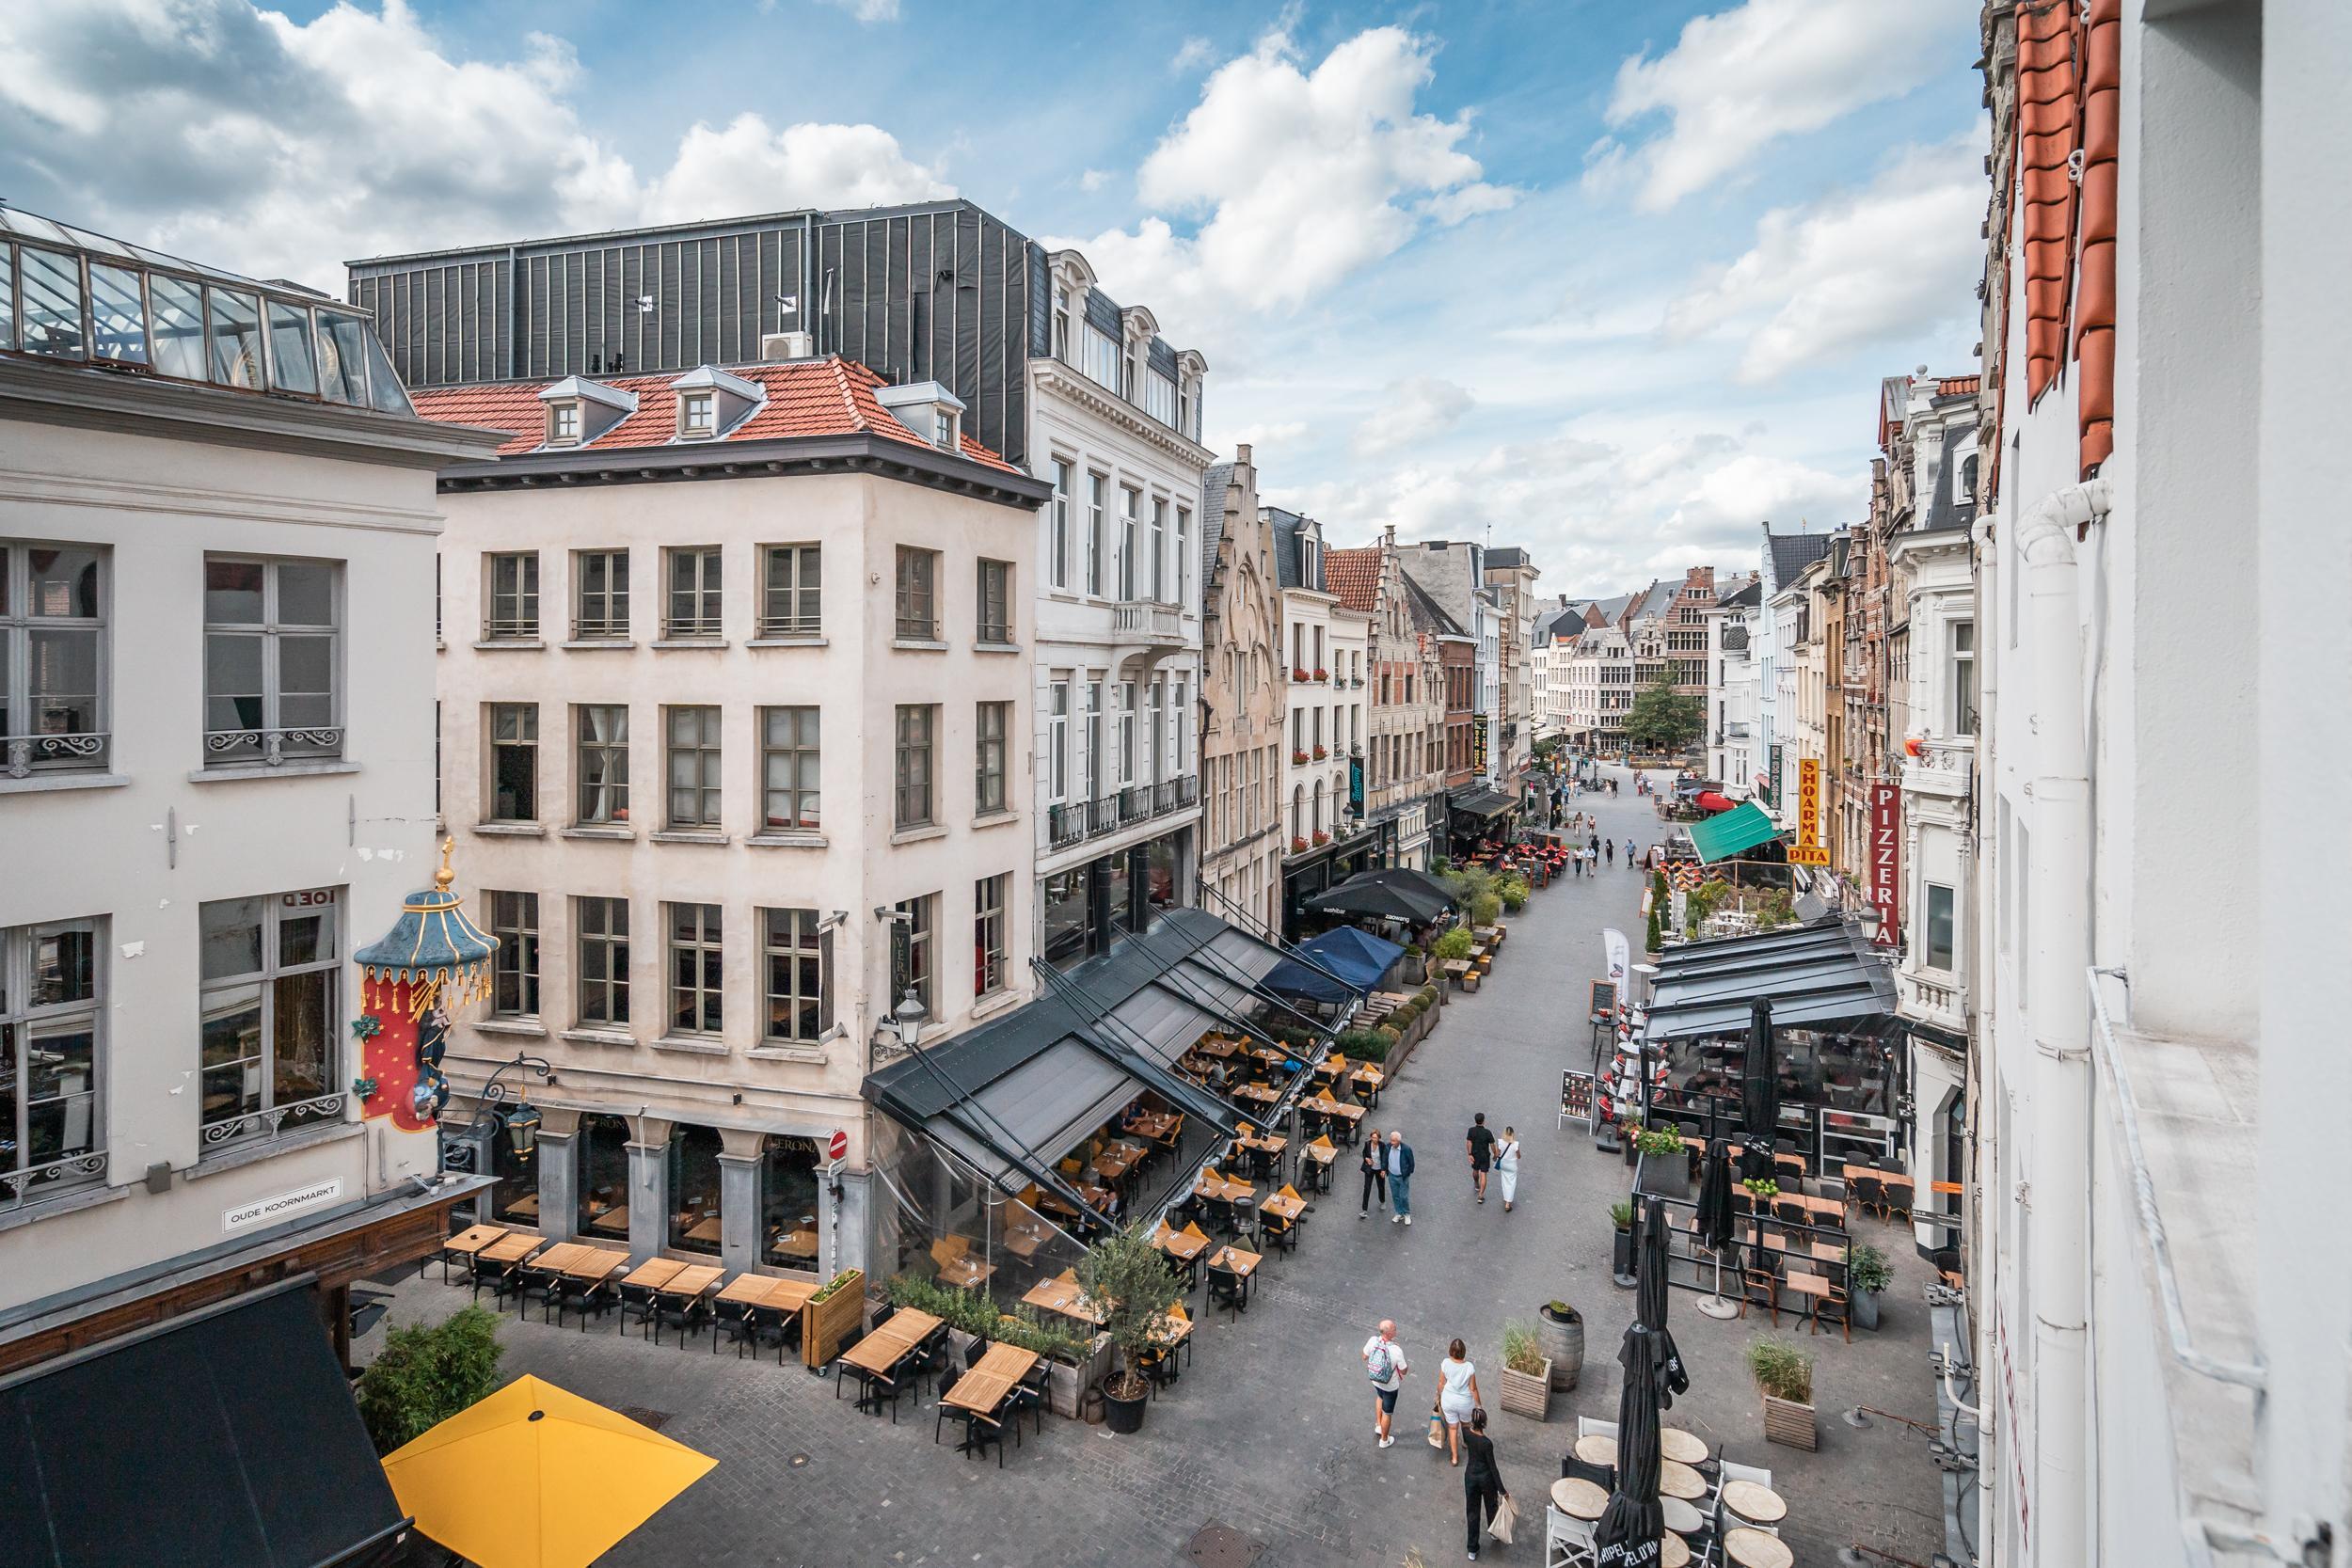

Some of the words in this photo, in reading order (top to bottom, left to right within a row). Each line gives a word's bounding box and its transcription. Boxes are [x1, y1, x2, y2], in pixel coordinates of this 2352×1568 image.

[1802, 761, 1816, 846] SHOARMA
[1789, 849, 1827, 863] PITA
[1877, 789, 1894, 943] PIZZERIA
[1385, 913, 1410, 924] zaowang
[896, 937, 905, 997] VERON
[230, 1208, 262, 1223] OUDE
[264, 1185, 336, 1213] KOORNMARKT
